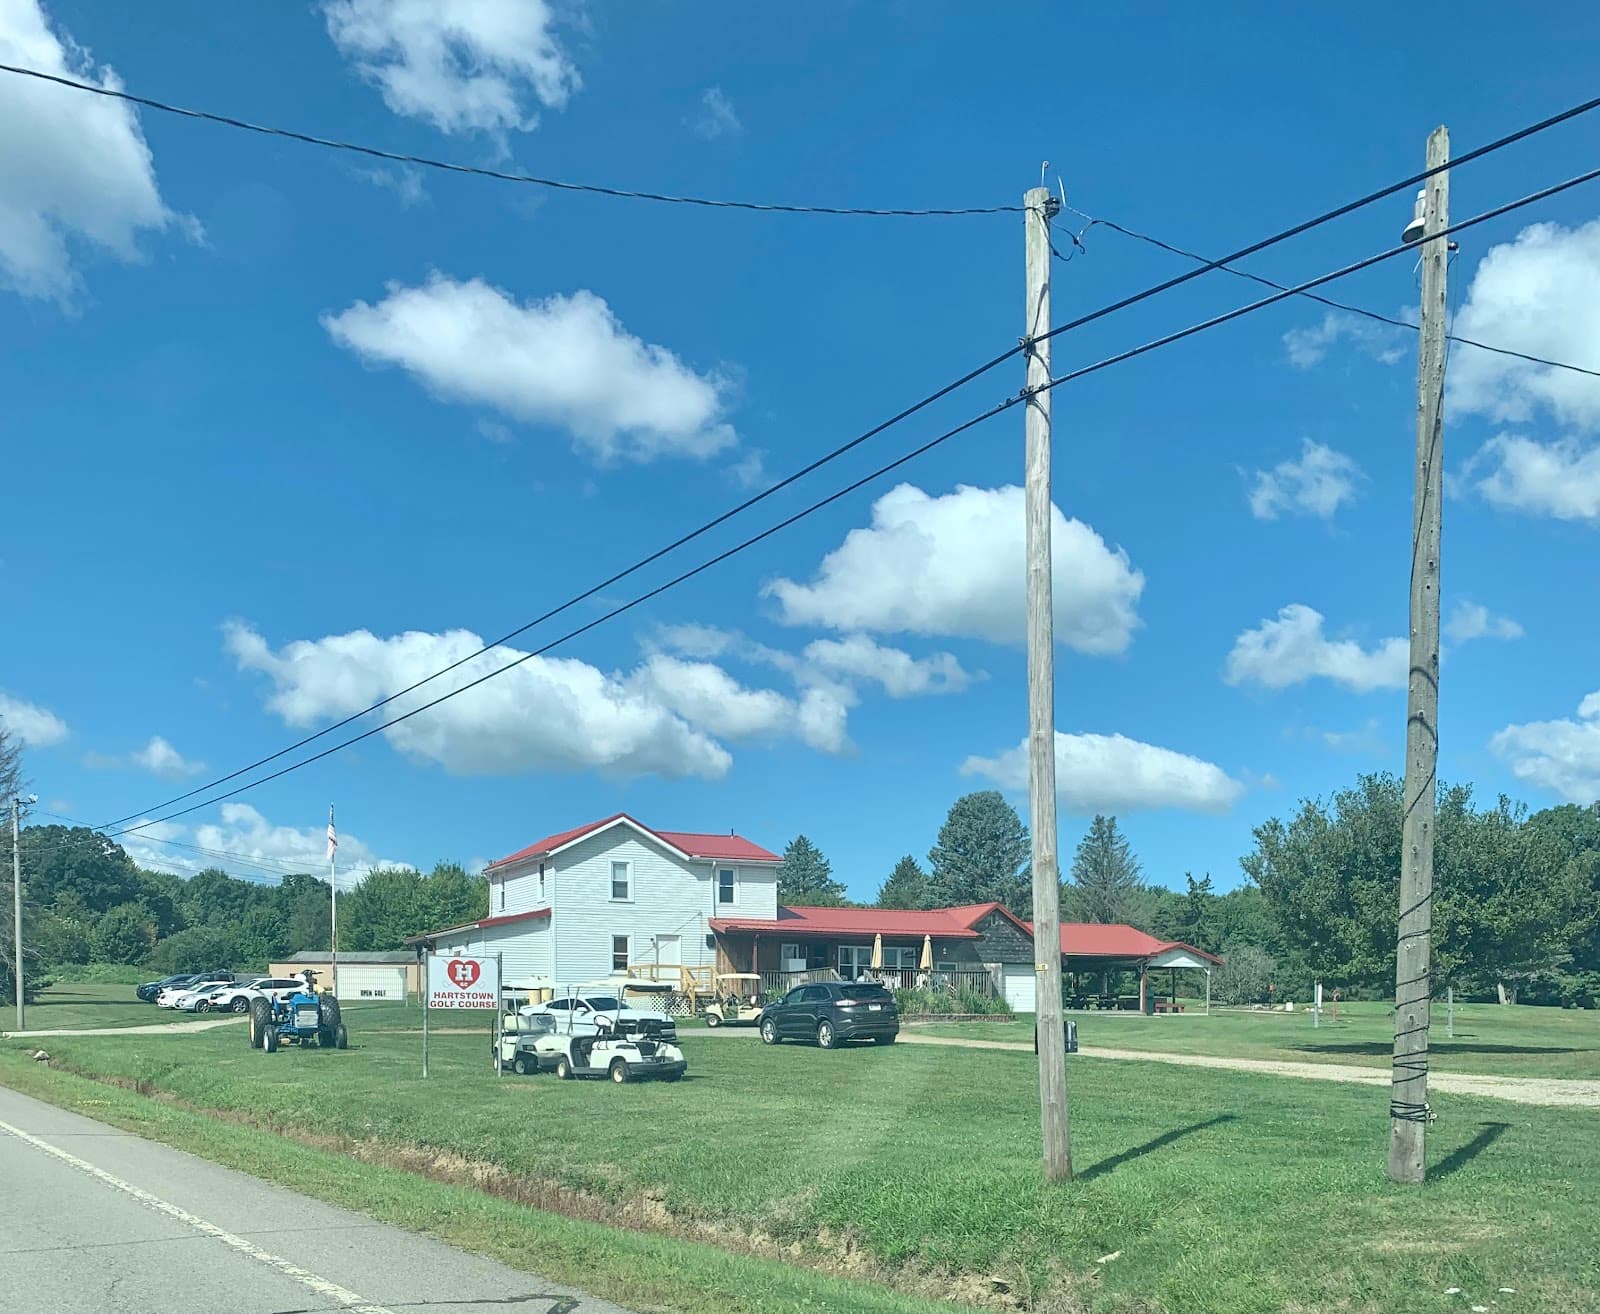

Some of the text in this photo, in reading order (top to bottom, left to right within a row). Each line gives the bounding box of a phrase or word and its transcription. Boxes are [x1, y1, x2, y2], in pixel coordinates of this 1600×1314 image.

[454, 964, 474, 981] H
[360, 989, 386, 997] OPEN GOLF
[433, 991, 494, 1000] HARTSTOWN
[430, 1000, 497, 1008] GOLF COURSE
